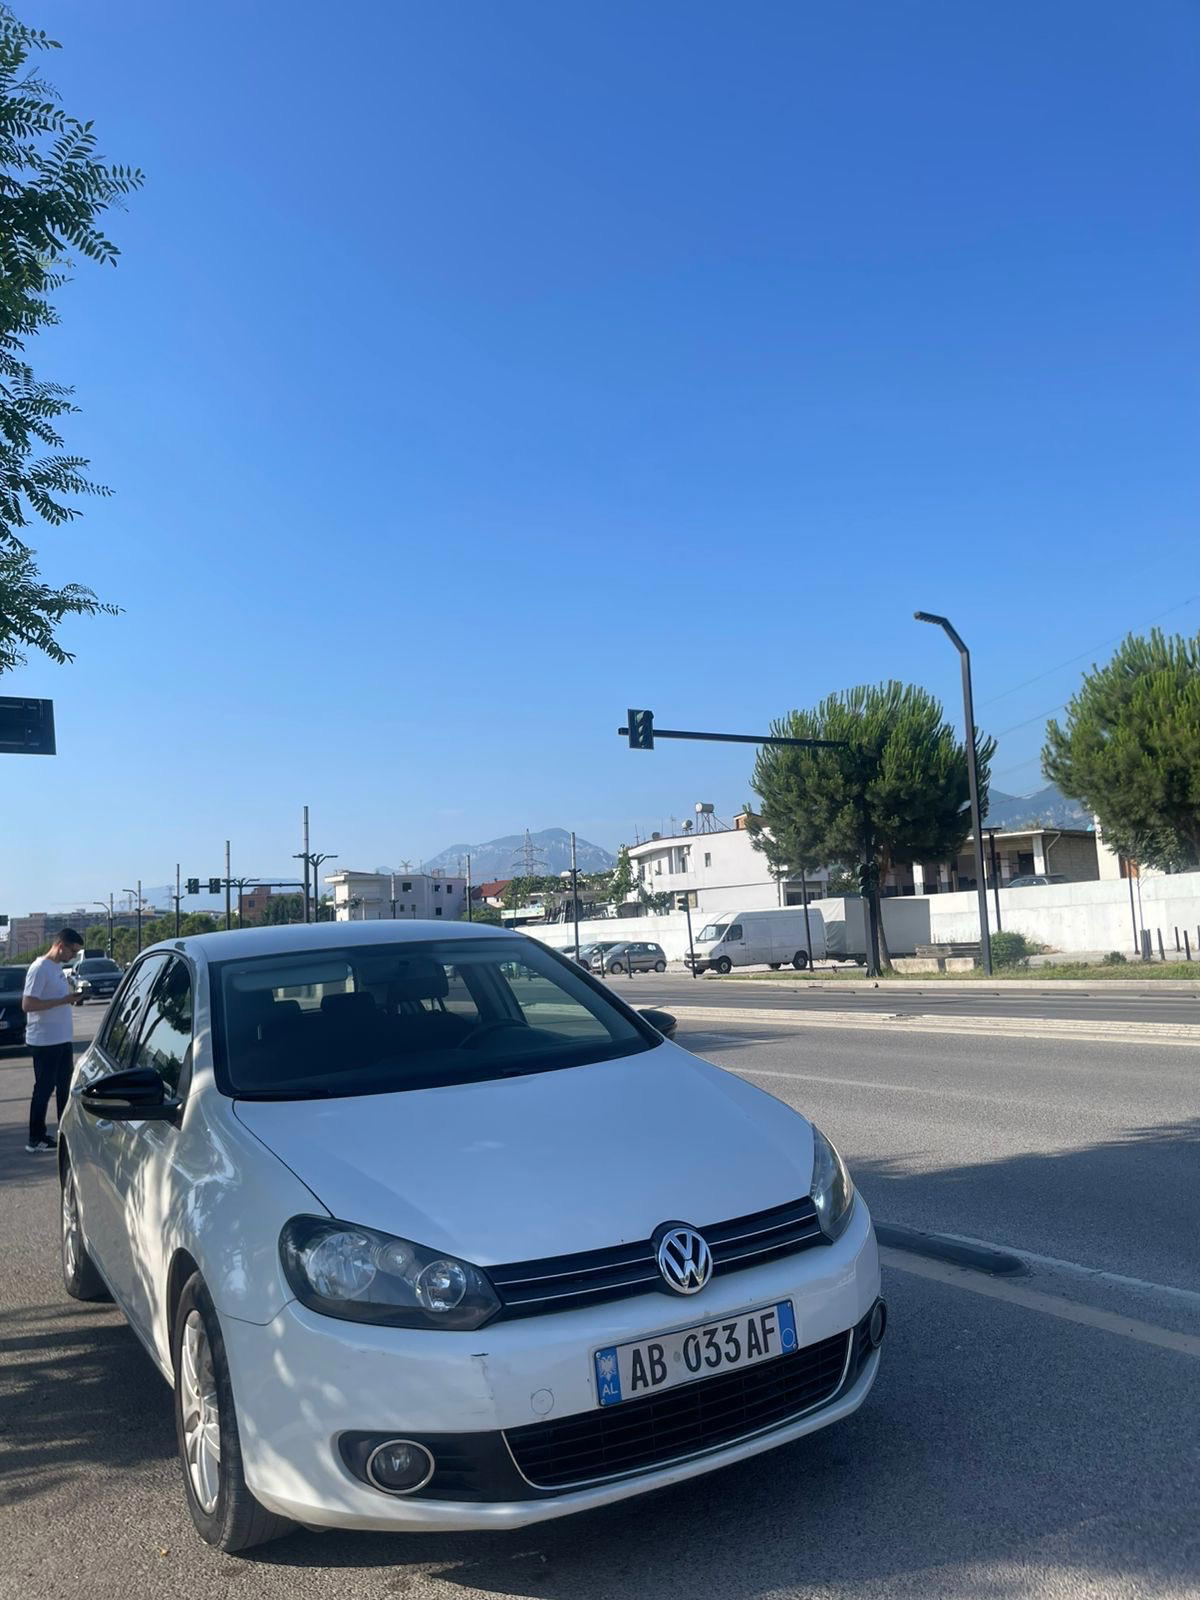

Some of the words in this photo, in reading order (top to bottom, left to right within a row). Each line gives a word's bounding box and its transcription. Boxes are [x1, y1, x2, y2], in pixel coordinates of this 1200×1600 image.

[659, 1229, 712, 1293] VW
[631, 1343, 668, 1391] AB
[683, 1323, 742, 1373] 033
[748, 1312, 775, 1359] AF
[602, 1383, 618, 1397] AL
